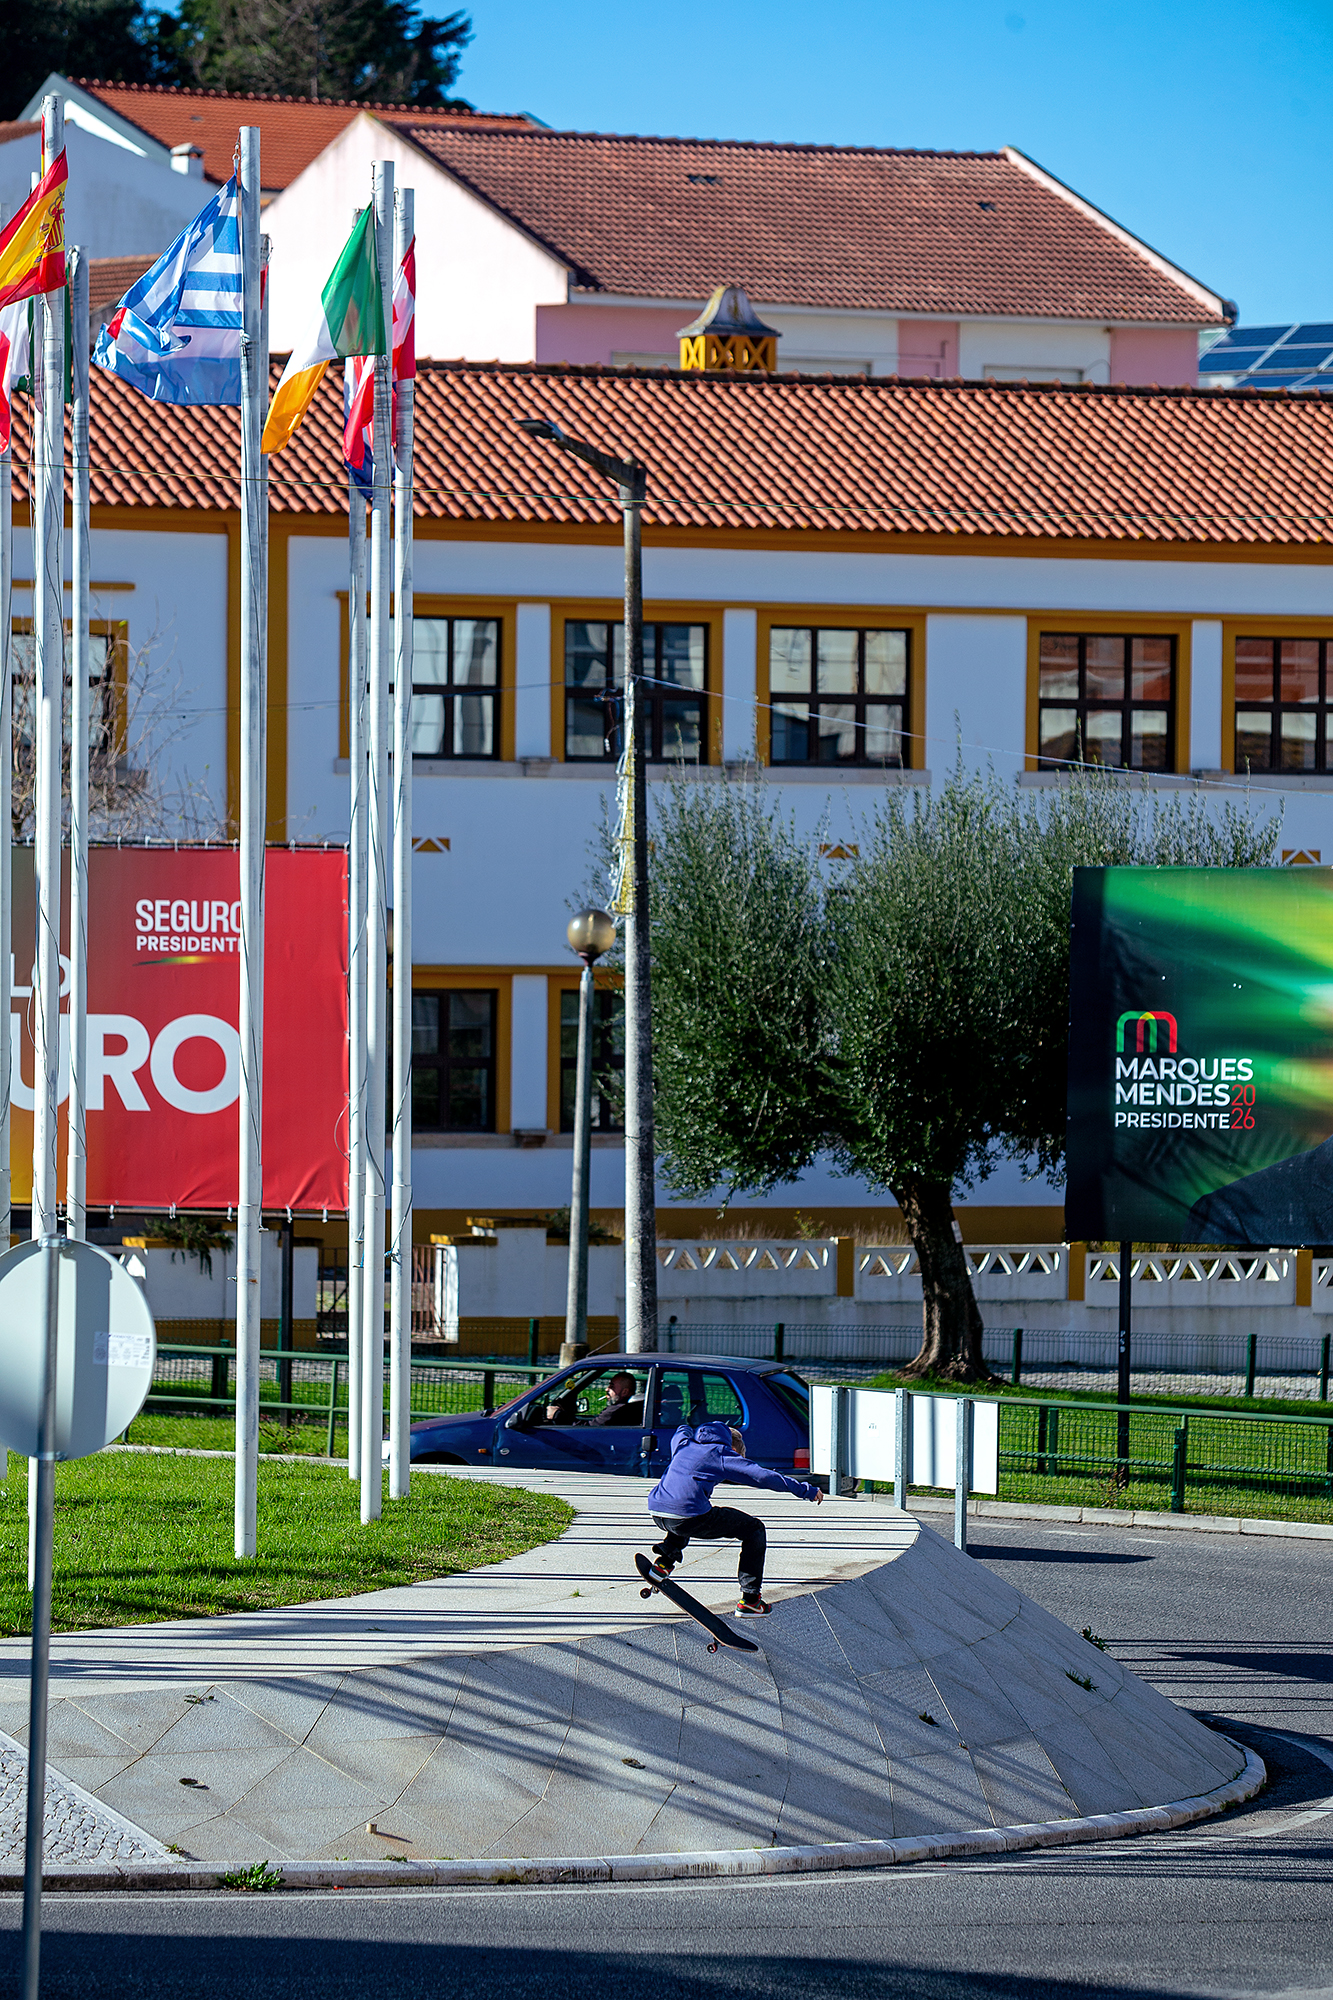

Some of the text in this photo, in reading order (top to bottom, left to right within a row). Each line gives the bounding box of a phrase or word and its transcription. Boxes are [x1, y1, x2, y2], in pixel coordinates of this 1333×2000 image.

[136, 935, 240, 953] PRESIDENT
[1115, 1057, 1253, 1085] MARQUES
[1115, 1083, 1256, 1107] MENDES 20
[1115, 1107, 1256, 1130] PRESIDENTE 26
